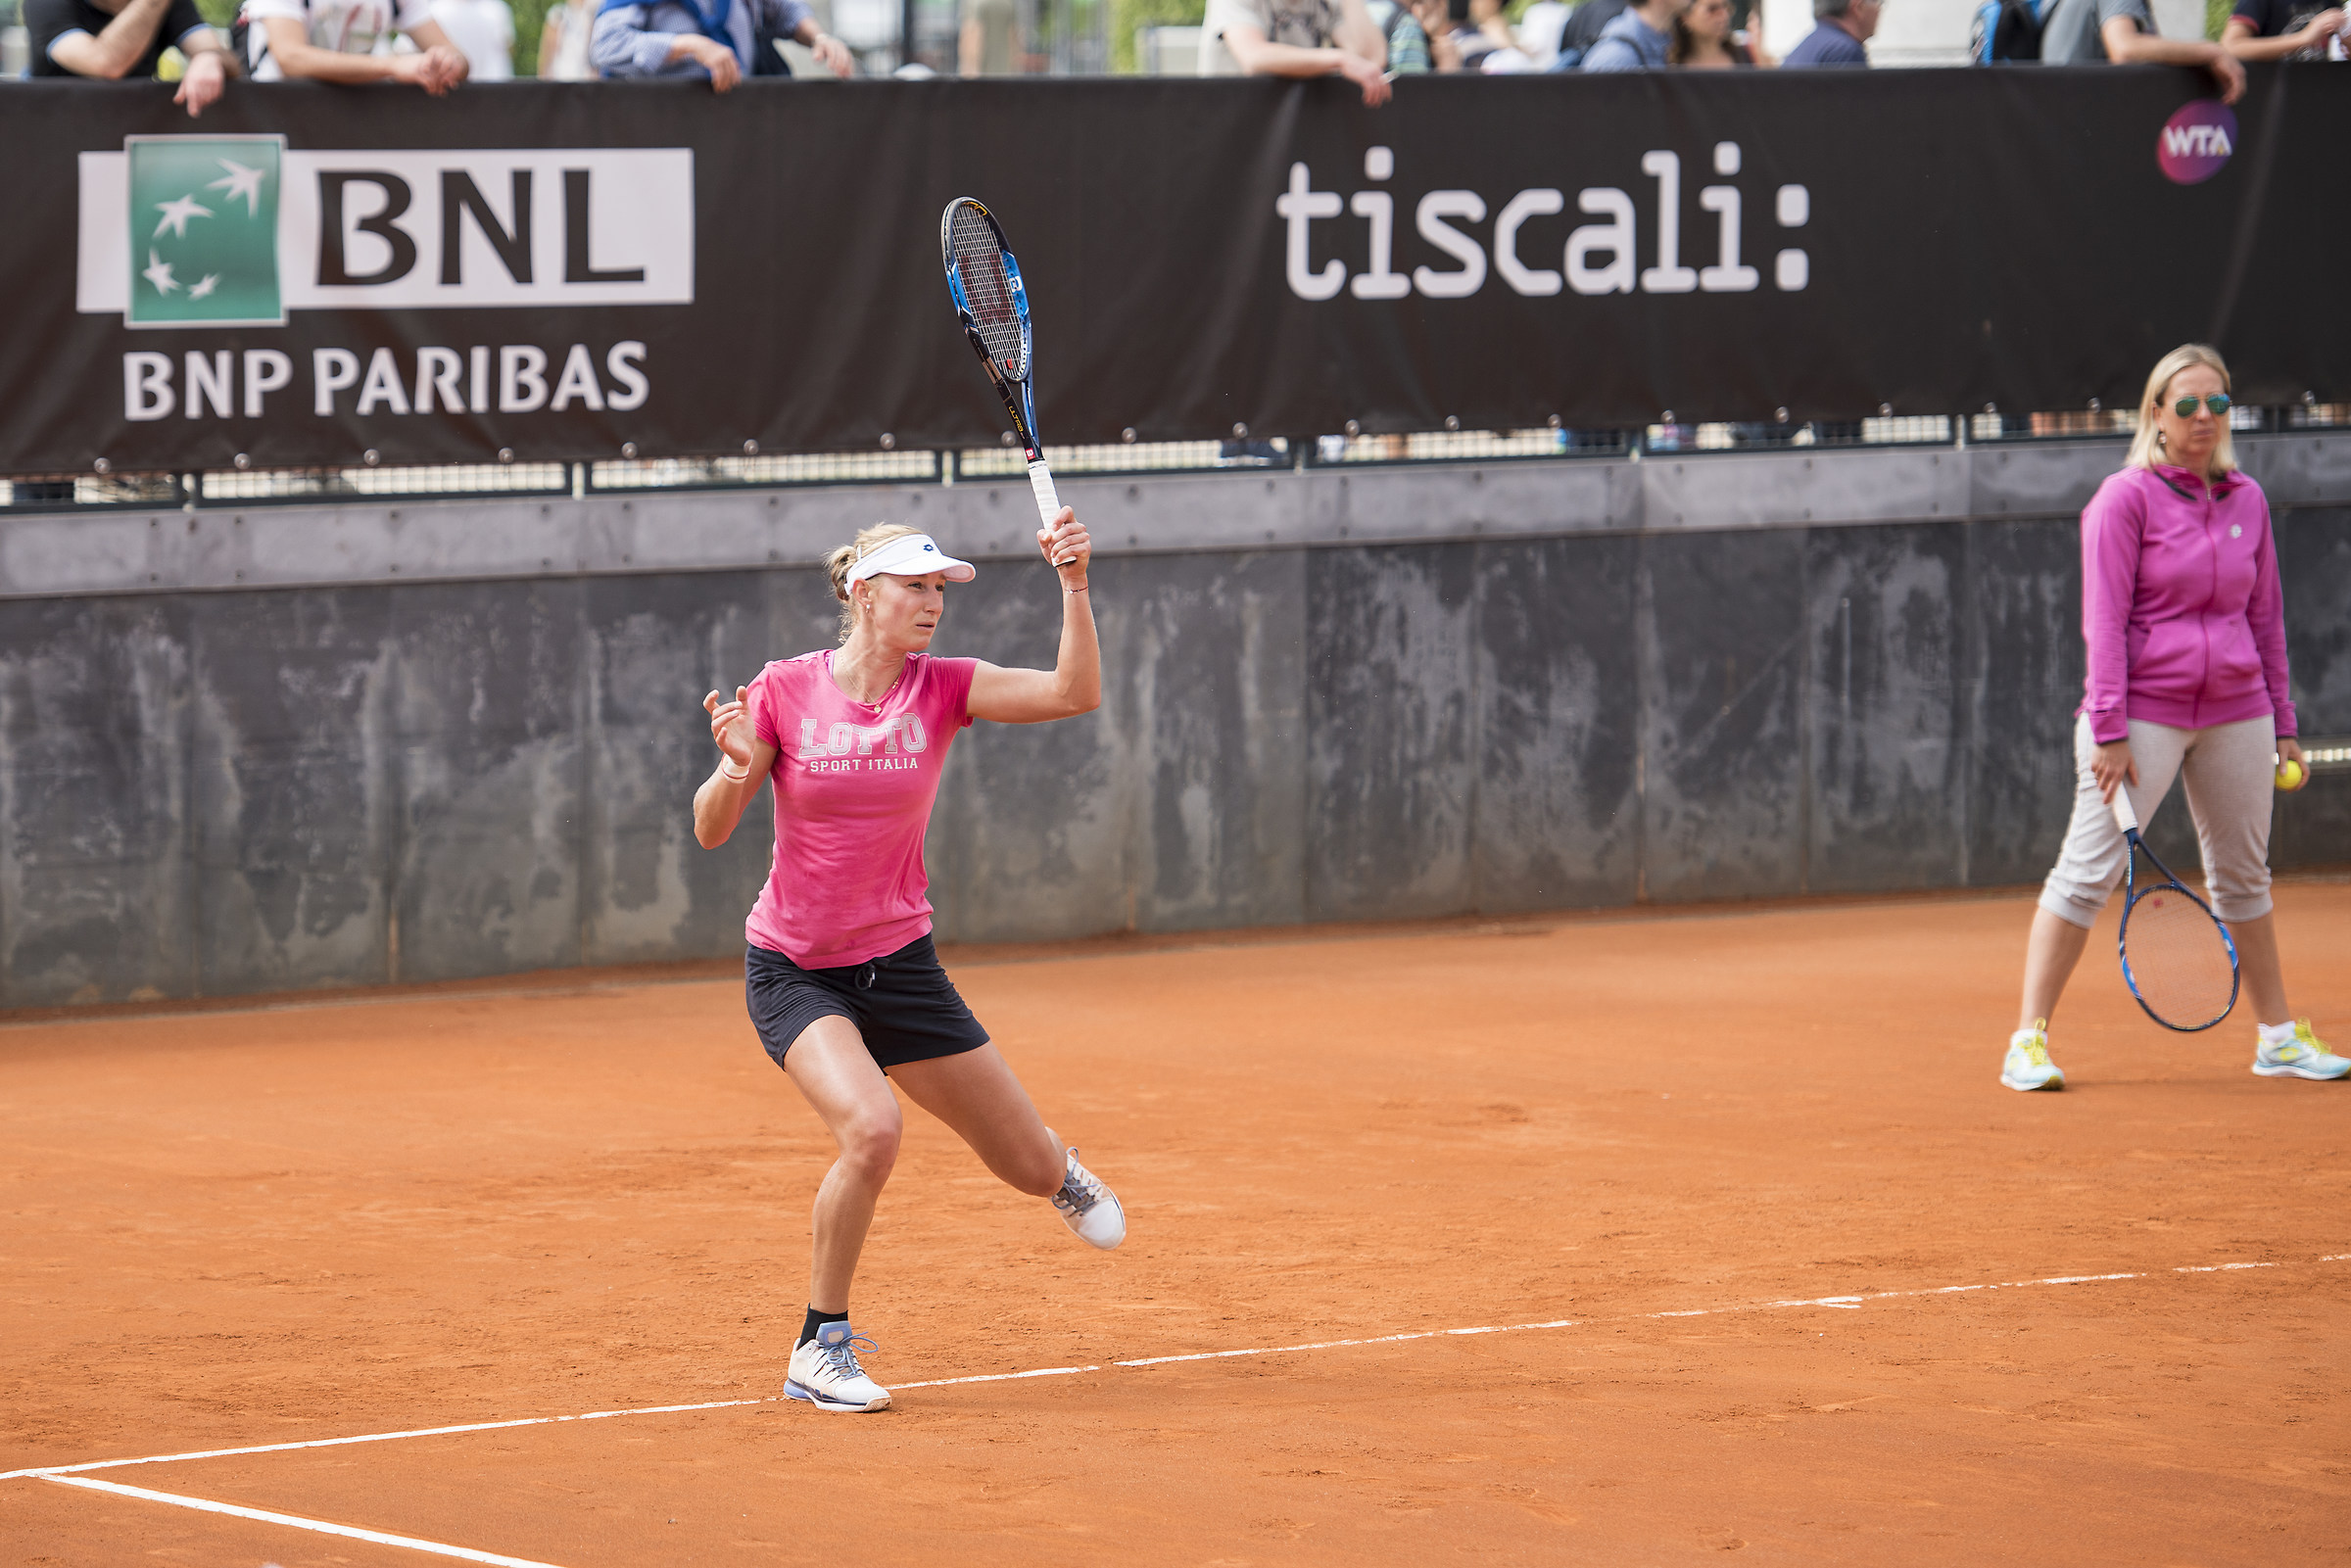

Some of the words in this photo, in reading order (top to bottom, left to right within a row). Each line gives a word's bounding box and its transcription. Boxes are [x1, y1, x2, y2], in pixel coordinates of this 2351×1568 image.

[2163, 123, 2232, 158] WTA
[316, 168, 647, 286] BNL
[123, 350, 293, 422] BNP
[312, 341, 650, 416] PARIBAS
[798, 712, 927, 758] LOTTO
[810, 759, 862, 773] SPORT
[868, 757, 919, 771] ITALIA
